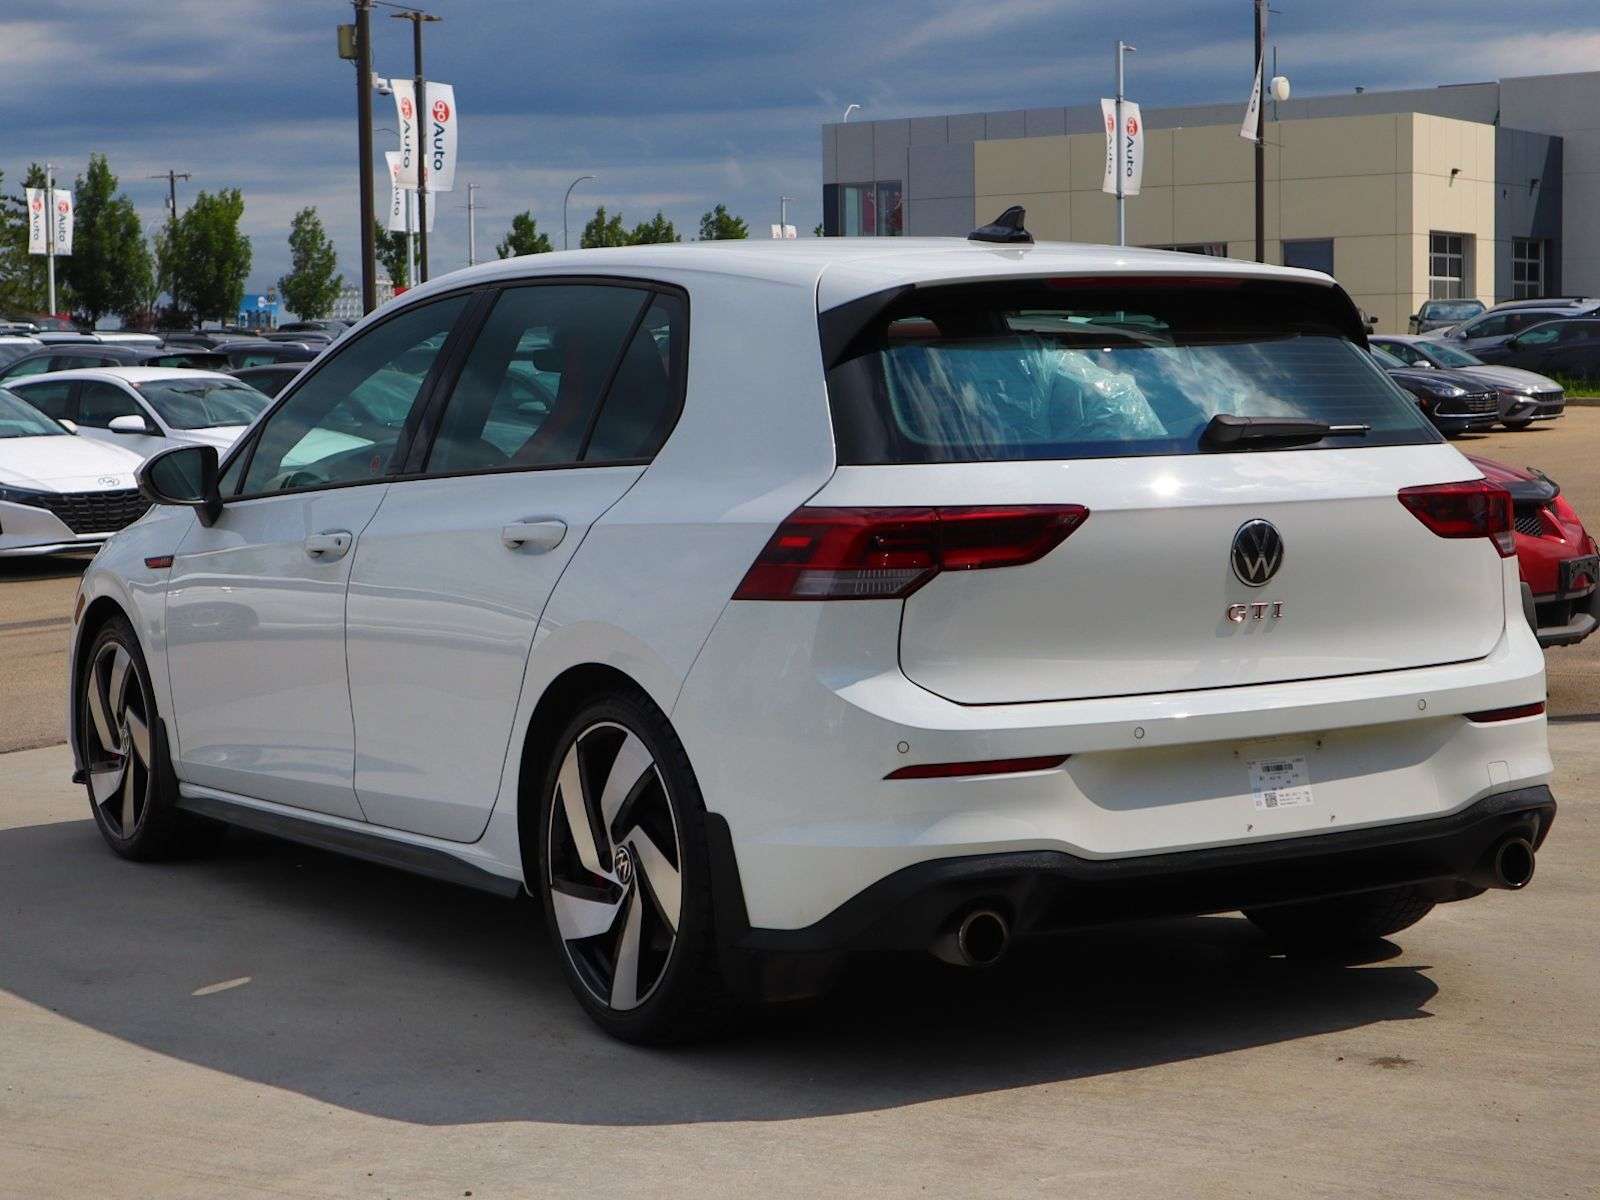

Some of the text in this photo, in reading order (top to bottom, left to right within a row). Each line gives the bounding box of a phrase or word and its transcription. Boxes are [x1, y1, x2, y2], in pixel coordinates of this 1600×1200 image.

[403, 119, 412, 168] Auto
[433, 122, 446, 171] Auto
[1126, 136, 1135, 178] Auto
[32, 213, 41, 240] Auto
[59, 213, 67, 242] Auto
[1226, 601, 1284, 622] GTI
